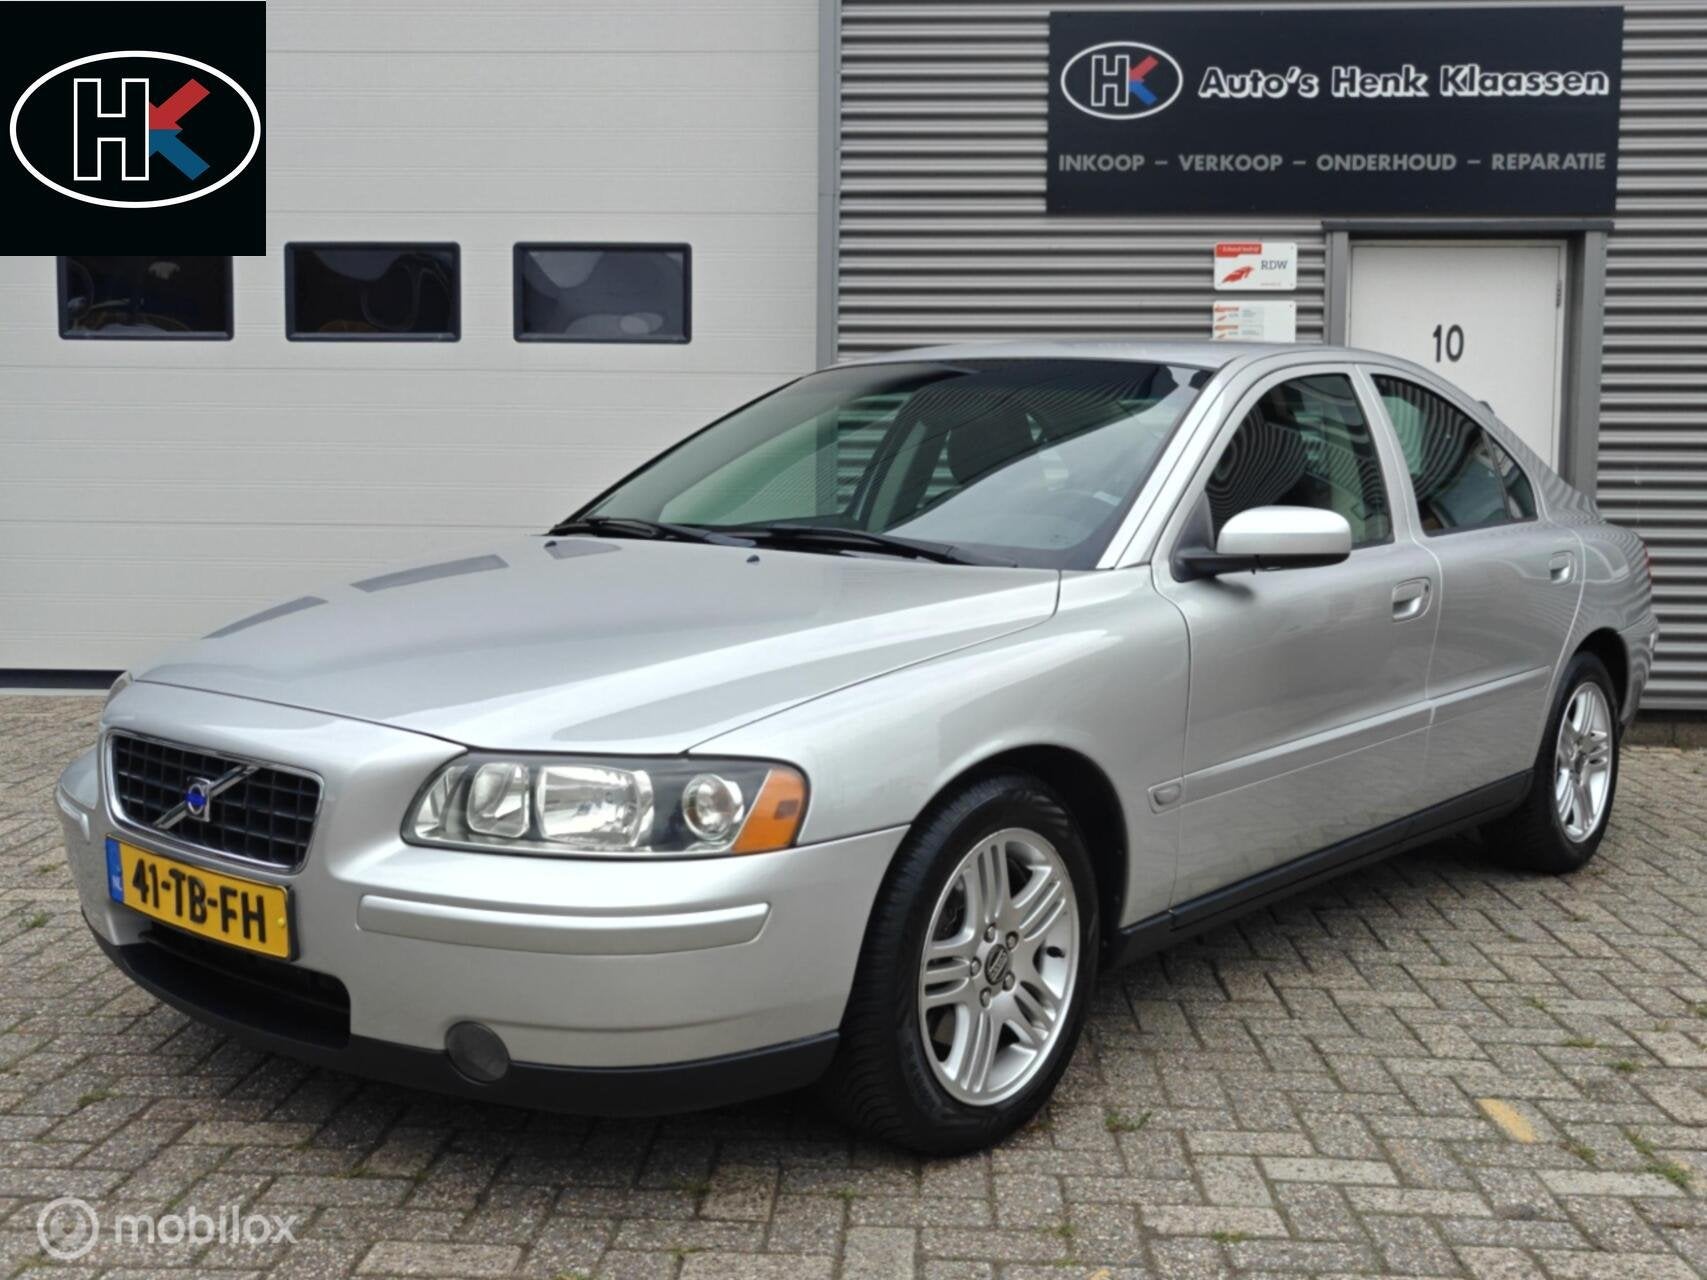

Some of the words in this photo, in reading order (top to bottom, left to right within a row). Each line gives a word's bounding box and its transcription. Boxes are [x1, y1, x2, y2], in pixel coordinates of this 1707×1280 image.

[1091, 54, 1158, 107] HK
[1198, 66, 1319, 99] Auto's
[1331, 63, 1430, 98] Henk
[1439, 62, 1610, 97] Klaassen
[1058, 154, 1145, 172] INKOOP
[1178, 154, 1283, 172] VERKOOP
[1316, 153, 1457, 171] ONDERHOUD
[1491, 152, 1606, 171] REPARATIE
[1260, 260, 1288, 270] RDW
[1432, 324, 1464, 363] 10
[132, 858, 266, 943] 41-TB-FH
